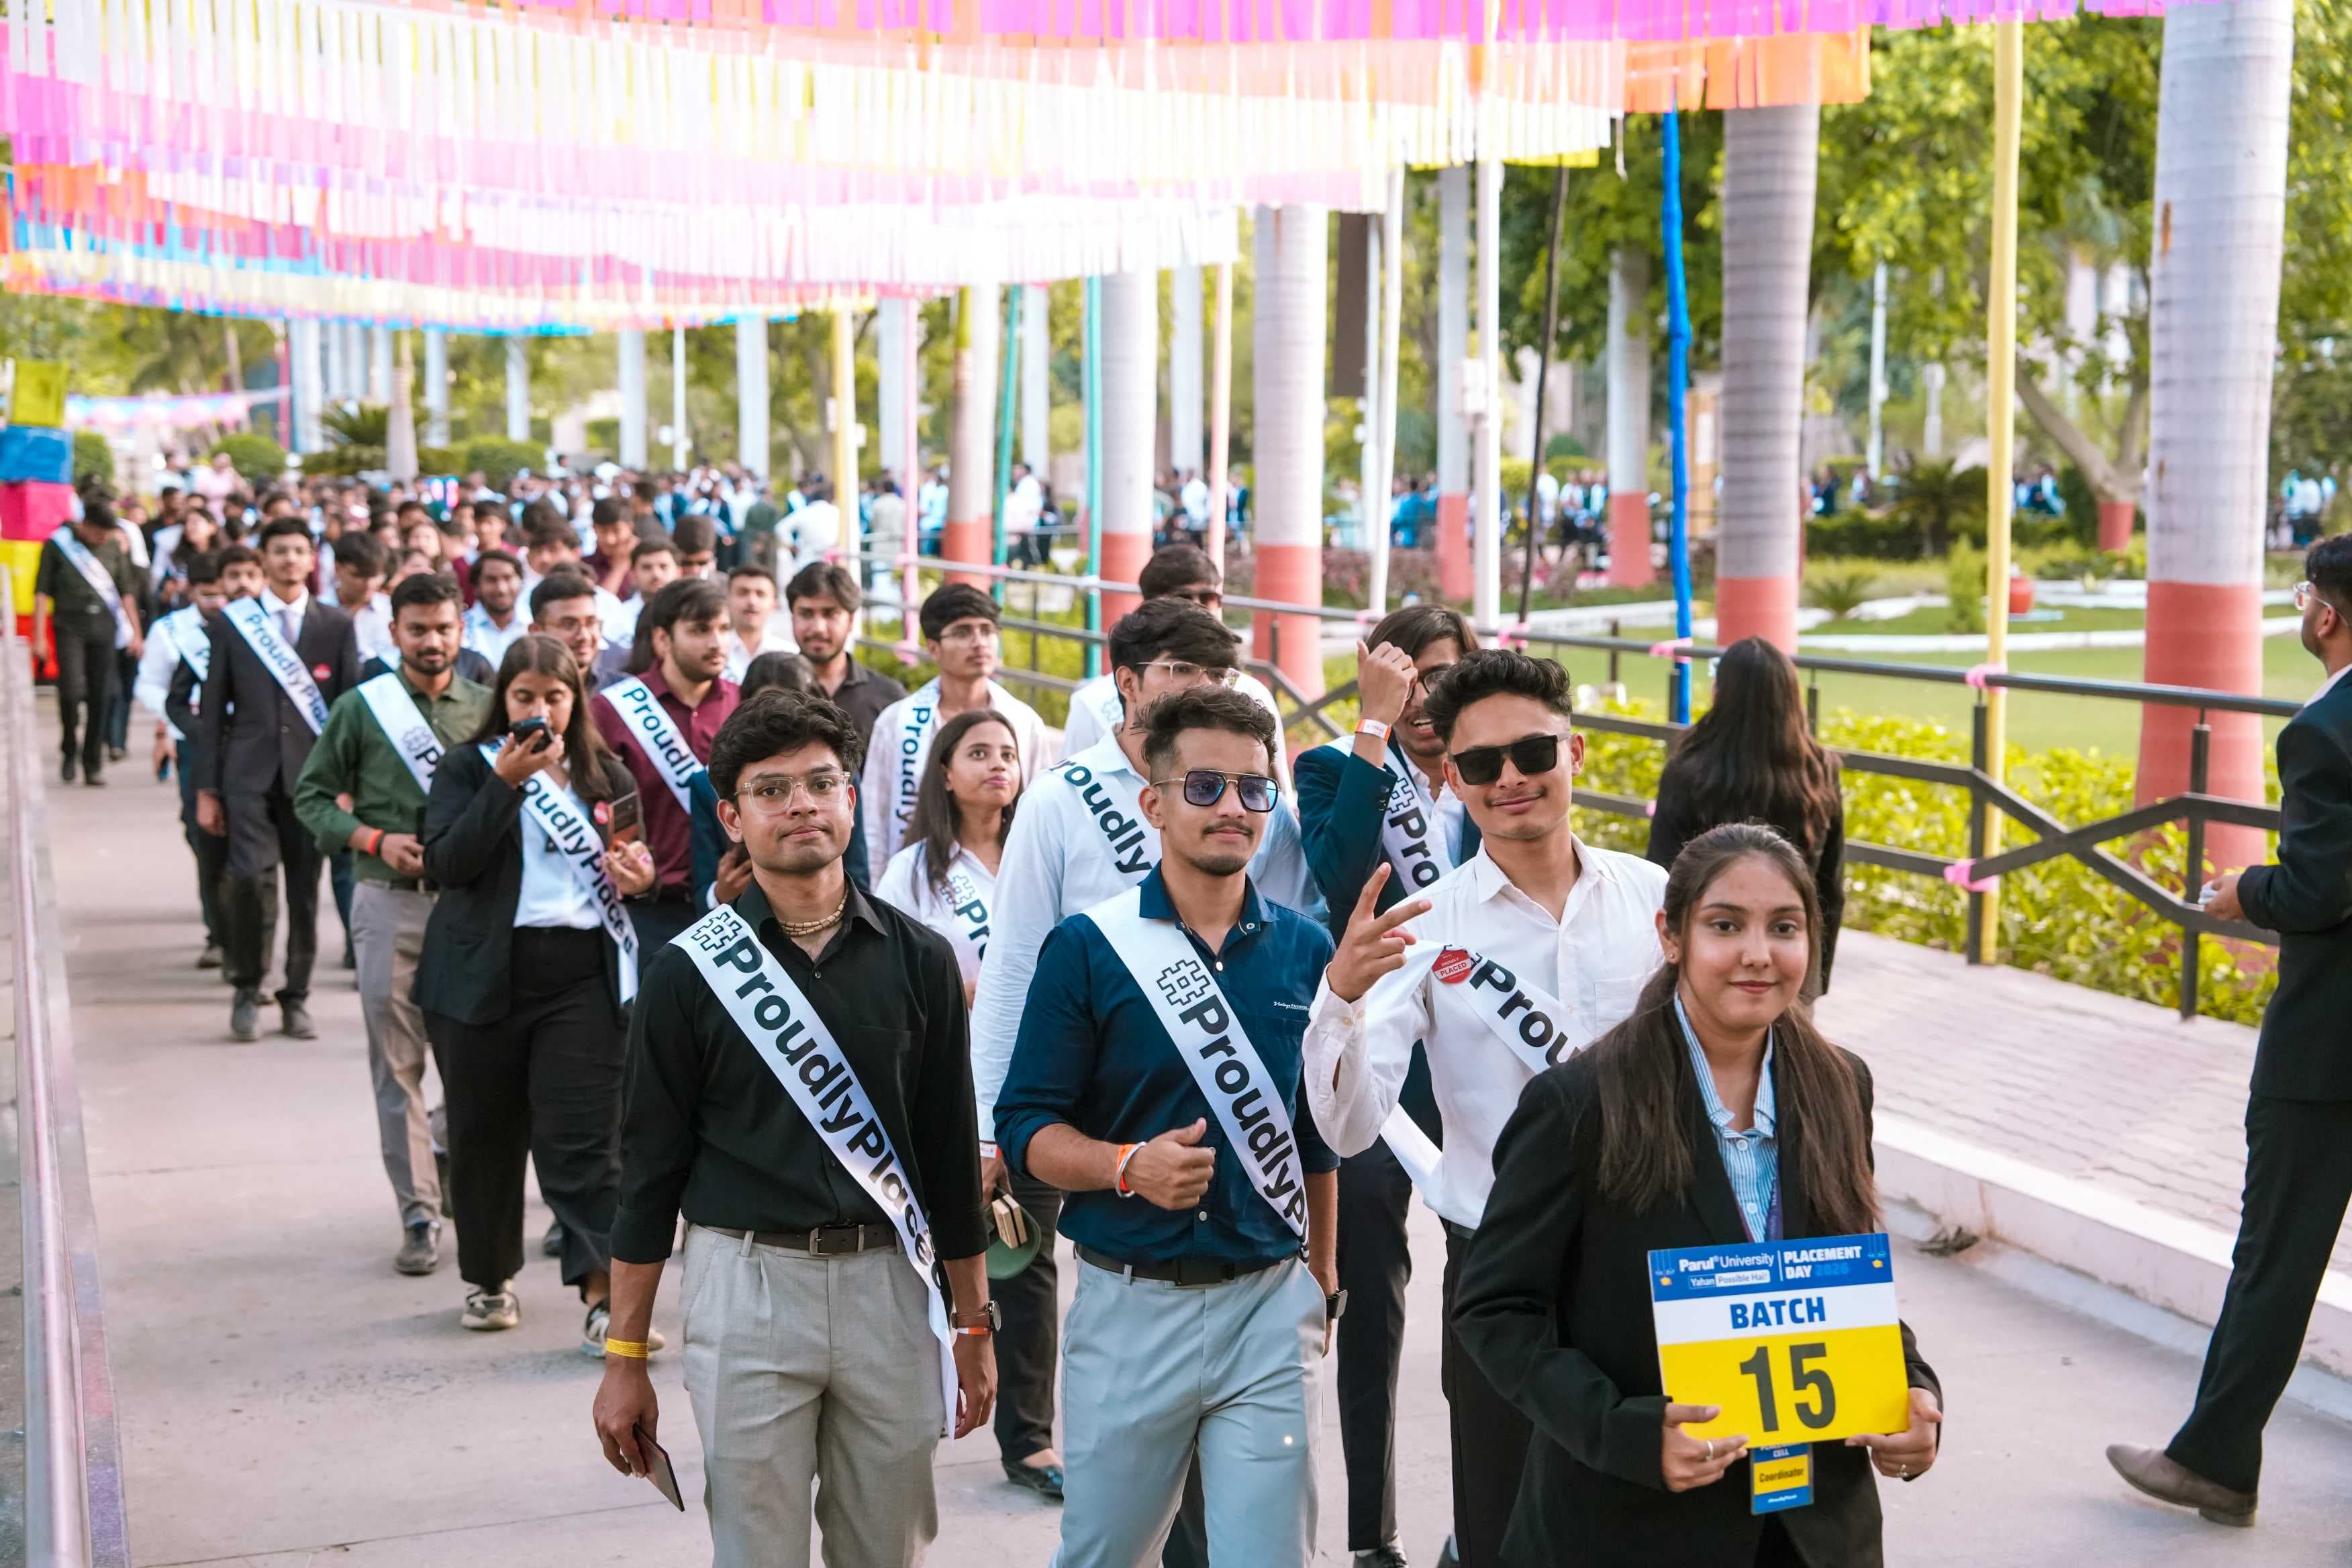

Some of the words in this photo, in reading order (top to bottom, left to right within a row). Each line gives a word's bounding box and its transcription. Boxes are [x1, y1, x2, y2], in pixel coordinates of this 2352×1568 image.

[940, 875, 990, 962] #Pr
[1440, 962, 1467, 976] PLACED
[1720, 1253, 1775, 1269] University
[1783, 1246, 1862, 1264] PLACEMENT
[1690, 1276, 1714, 1287] Yahan
[1718, 1273, 1749, 1285] Possible
[1785, 1265, 1812, 1279] DAY
[1730, 1297, 1826, 1329] BATCH
[1739, 1342, 1836, 1432] 15
[1759, 1468, 1804, 1483] Coordinator
